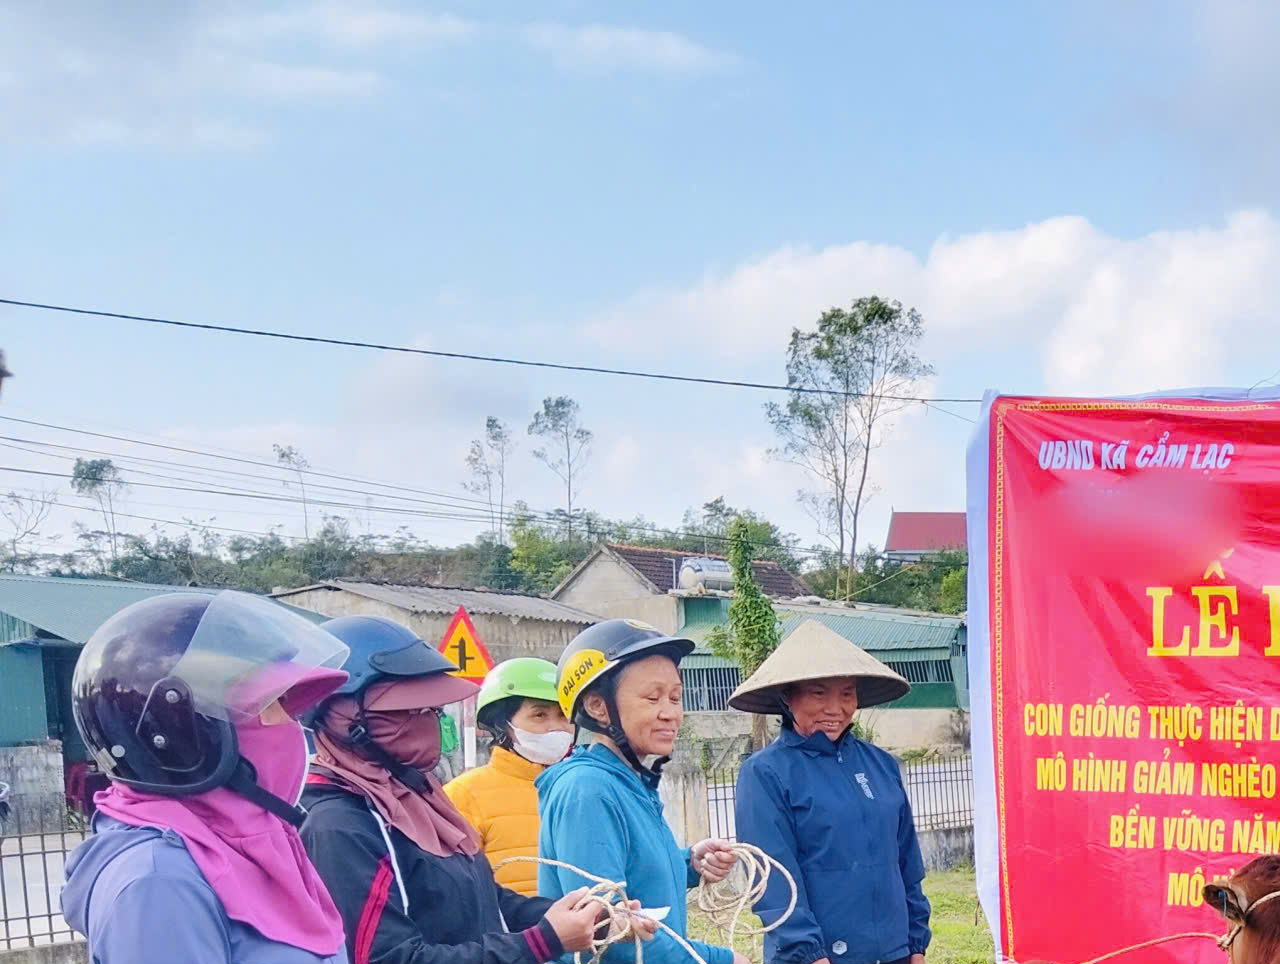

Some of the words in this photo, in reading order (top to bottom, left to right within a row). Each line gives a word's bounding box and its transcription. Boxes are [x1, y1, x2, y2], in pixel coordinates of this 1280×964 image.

[1038, 440, 1094, 470] UBND
[1135, 431, 1188, 469] CẨM
[1190, 442, 1235, 475] LẠC
[1023, 703, 1064, 737] CON
[1069, 697, 1141, 739] GIỐNG
[1147, 703, 1203, 747] THỰC
[1210, 699, 1264, 748] HIỆN
[1036, 751, 1067, 791] MÔ
[1072, 753, 1127, 793] HÌNH
[1133, 748, 1195, 796] GIẢM
[1201, 756, 1276, 798] NGHÈO
[1109, 804, 1156, 849] BỀN
[1163, 809, 1226, 853] VỮNG
[1167, 866, 1206, 907] MÔ
